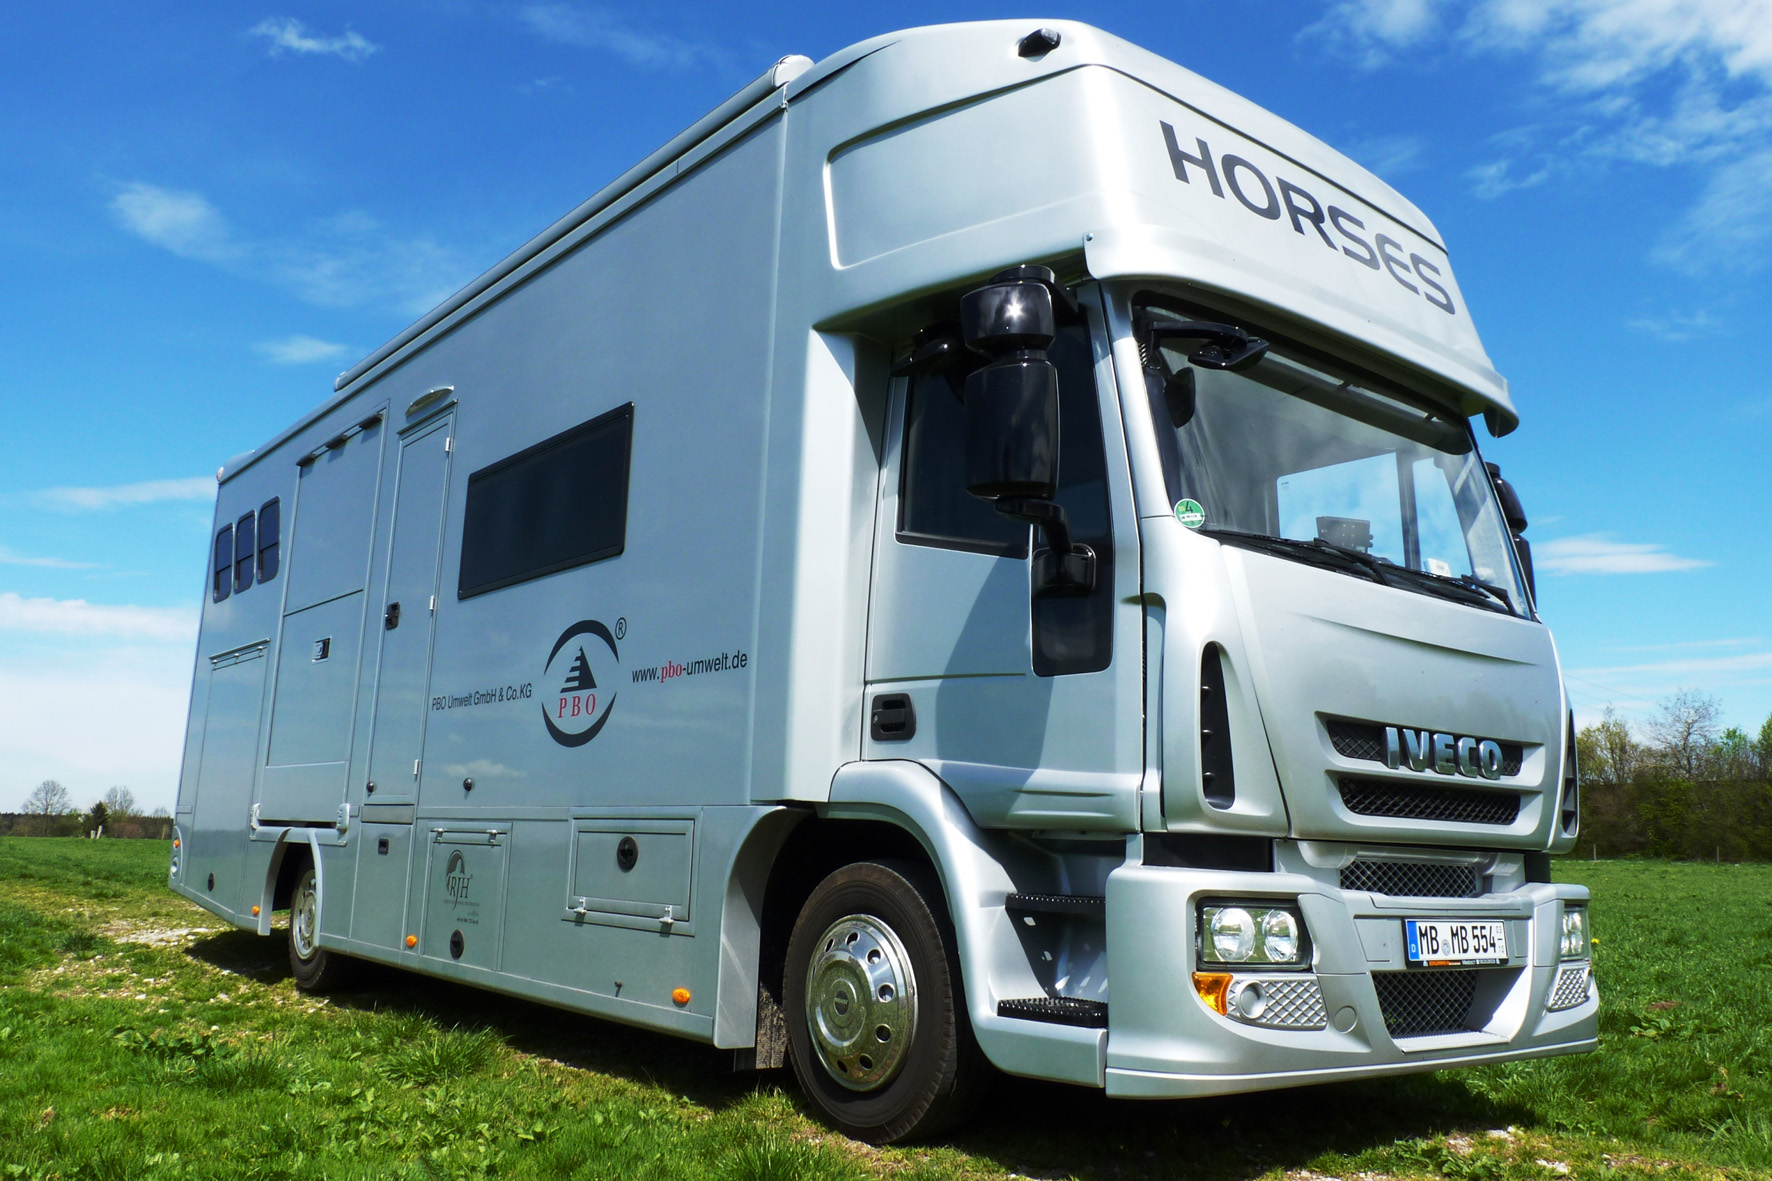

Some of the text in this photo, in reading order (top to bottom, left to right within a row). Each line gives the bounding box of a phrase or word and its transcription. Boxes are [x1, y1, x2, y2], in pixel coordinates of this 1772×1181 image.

[1159, 120, 1456, 315] HORSES
[1185, 501, 1194, 513] 4
[631, 650, 748, 684] www.pbo-umwelt.de
[432, 695, 447, 711] PBO
[447, 692, 472, 709] Umwelt
[473, 688, 497, 706] GmbH
[498, 687, 504, 702] &
[557, 693, 597, 719] PBO
[1385, 727, 1503, 780] IVECO
[1418, 925, 1497, 955] MB MB 554
